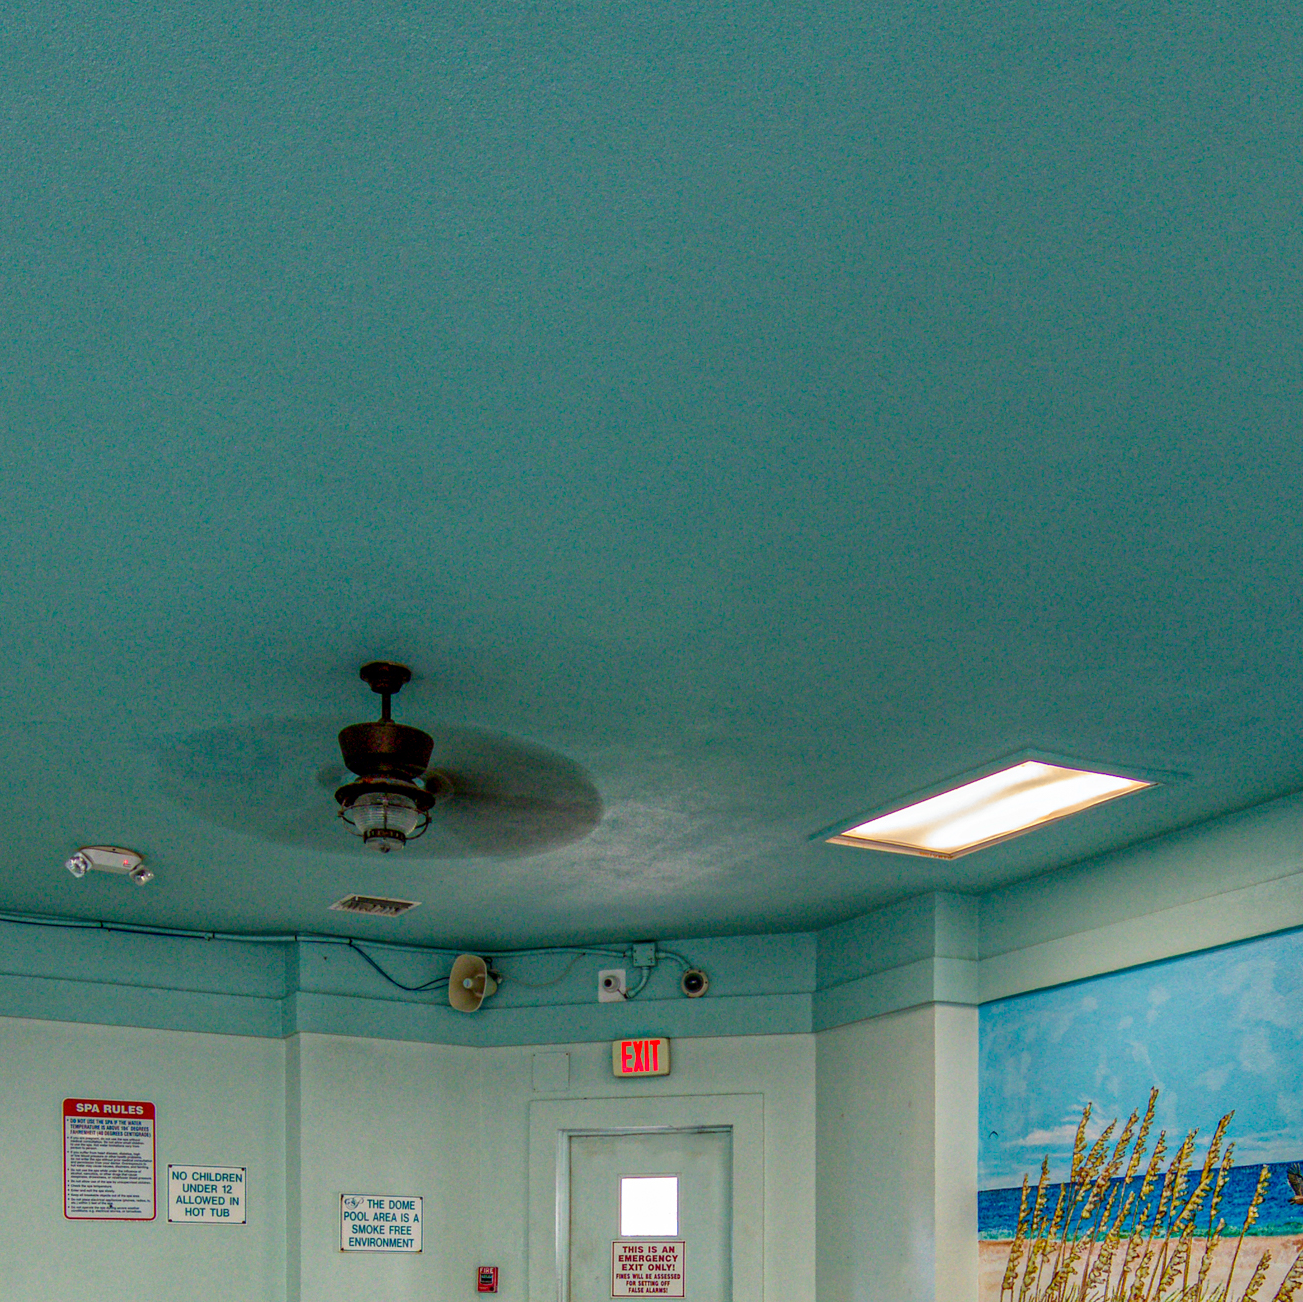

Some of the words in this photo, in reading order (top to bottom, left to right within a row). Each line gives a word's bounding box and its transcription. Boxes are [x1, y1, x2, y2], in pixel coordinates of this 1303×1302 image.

[621, 1040, 661, 1073] EXIT
[76, 1103, 100, 1113] SPA
[103, 1104, 144, 1115] RULES
[172, 1171, 187, 1180] NO
[192, 1172, 243, 1182] CHILDREN
[183, 1184, 218, 1193] UNDER
[222, 1184, 232, 1194] 12
[176, 1195, 225, 1206] ALLOWED
[230, 1197, 239, 1206] IN
[367, 1199, 385, 1209] THE
[389, 1200, 415, 1210] DOME
[185, 1207, 206, 1216] HOT
[210, 1208, 230, 1217] TUB
[344, 1211, 369, 1222] POOL
[373, 1212, 397, 1222] AREA
[400, 1213, 409, 1222] IS
[413, 1214, 420, 1222] A
[352, 1224, 385, 1234] SMOKE
[389, 1226, 412, 1235] FREE
[348, 1237, 415, 1248] ENVIRONMENT
